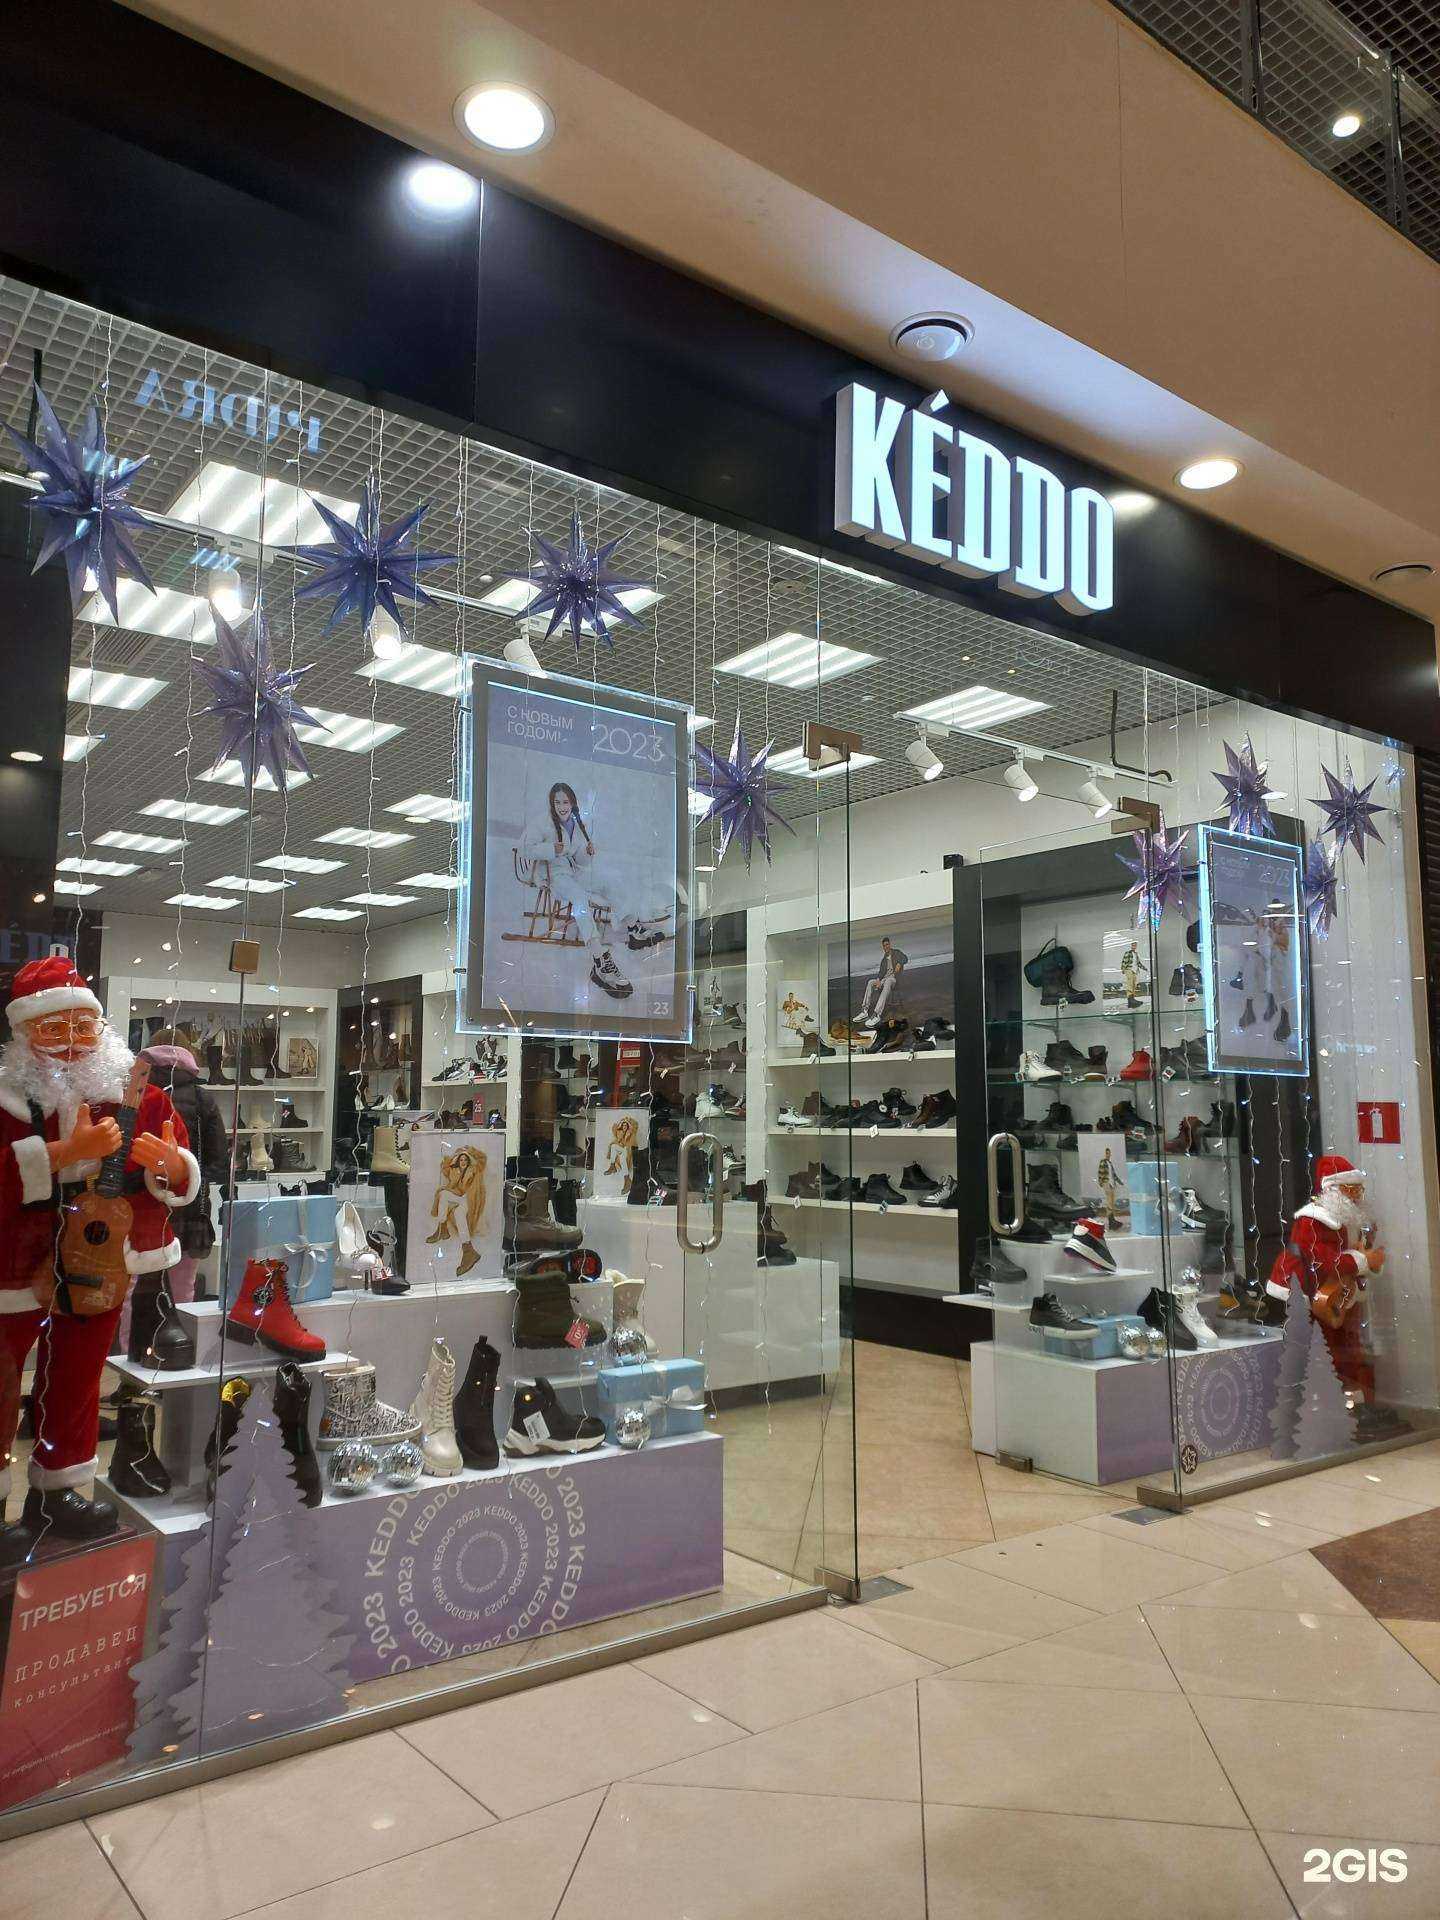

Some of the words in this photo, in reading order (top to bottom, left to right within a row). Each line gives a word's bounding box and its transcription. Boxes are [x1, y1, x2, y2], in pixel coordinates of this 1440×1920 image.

[842, 382, 1114, 613] KÉDDO
[507, 705, 518, 718] С
[521, 708, 573, 730] НОВЫМ
[507, 720, 560, 743] ГОДОМ!
[593, 724, 665, 762] 2023
[653, 1001, 668, 1015] 23
[406, 1483, 460, 1546] KEDDO
[509, 1474, 554, 1521] KEDDO
[557, 1477, 586, 1538] 2023
[432, 1527, 456, 1571] KEDDO
[484, 1505, 518, 1525] KEDDO
[544, 1523, 560, 1570] 2023
[19, 1572, 147, 1632] ТРЕБУЕТСЯ
[398, 1556, 416, 1607] 2023
[507, 1575, 554, 1640] KEDDO
[363, 1592, 398, 1659] 2023
[404, 1608, 454, 1659] KEDDO
[13, 1626, 138, 1684] ПРОДАВЕЦ
